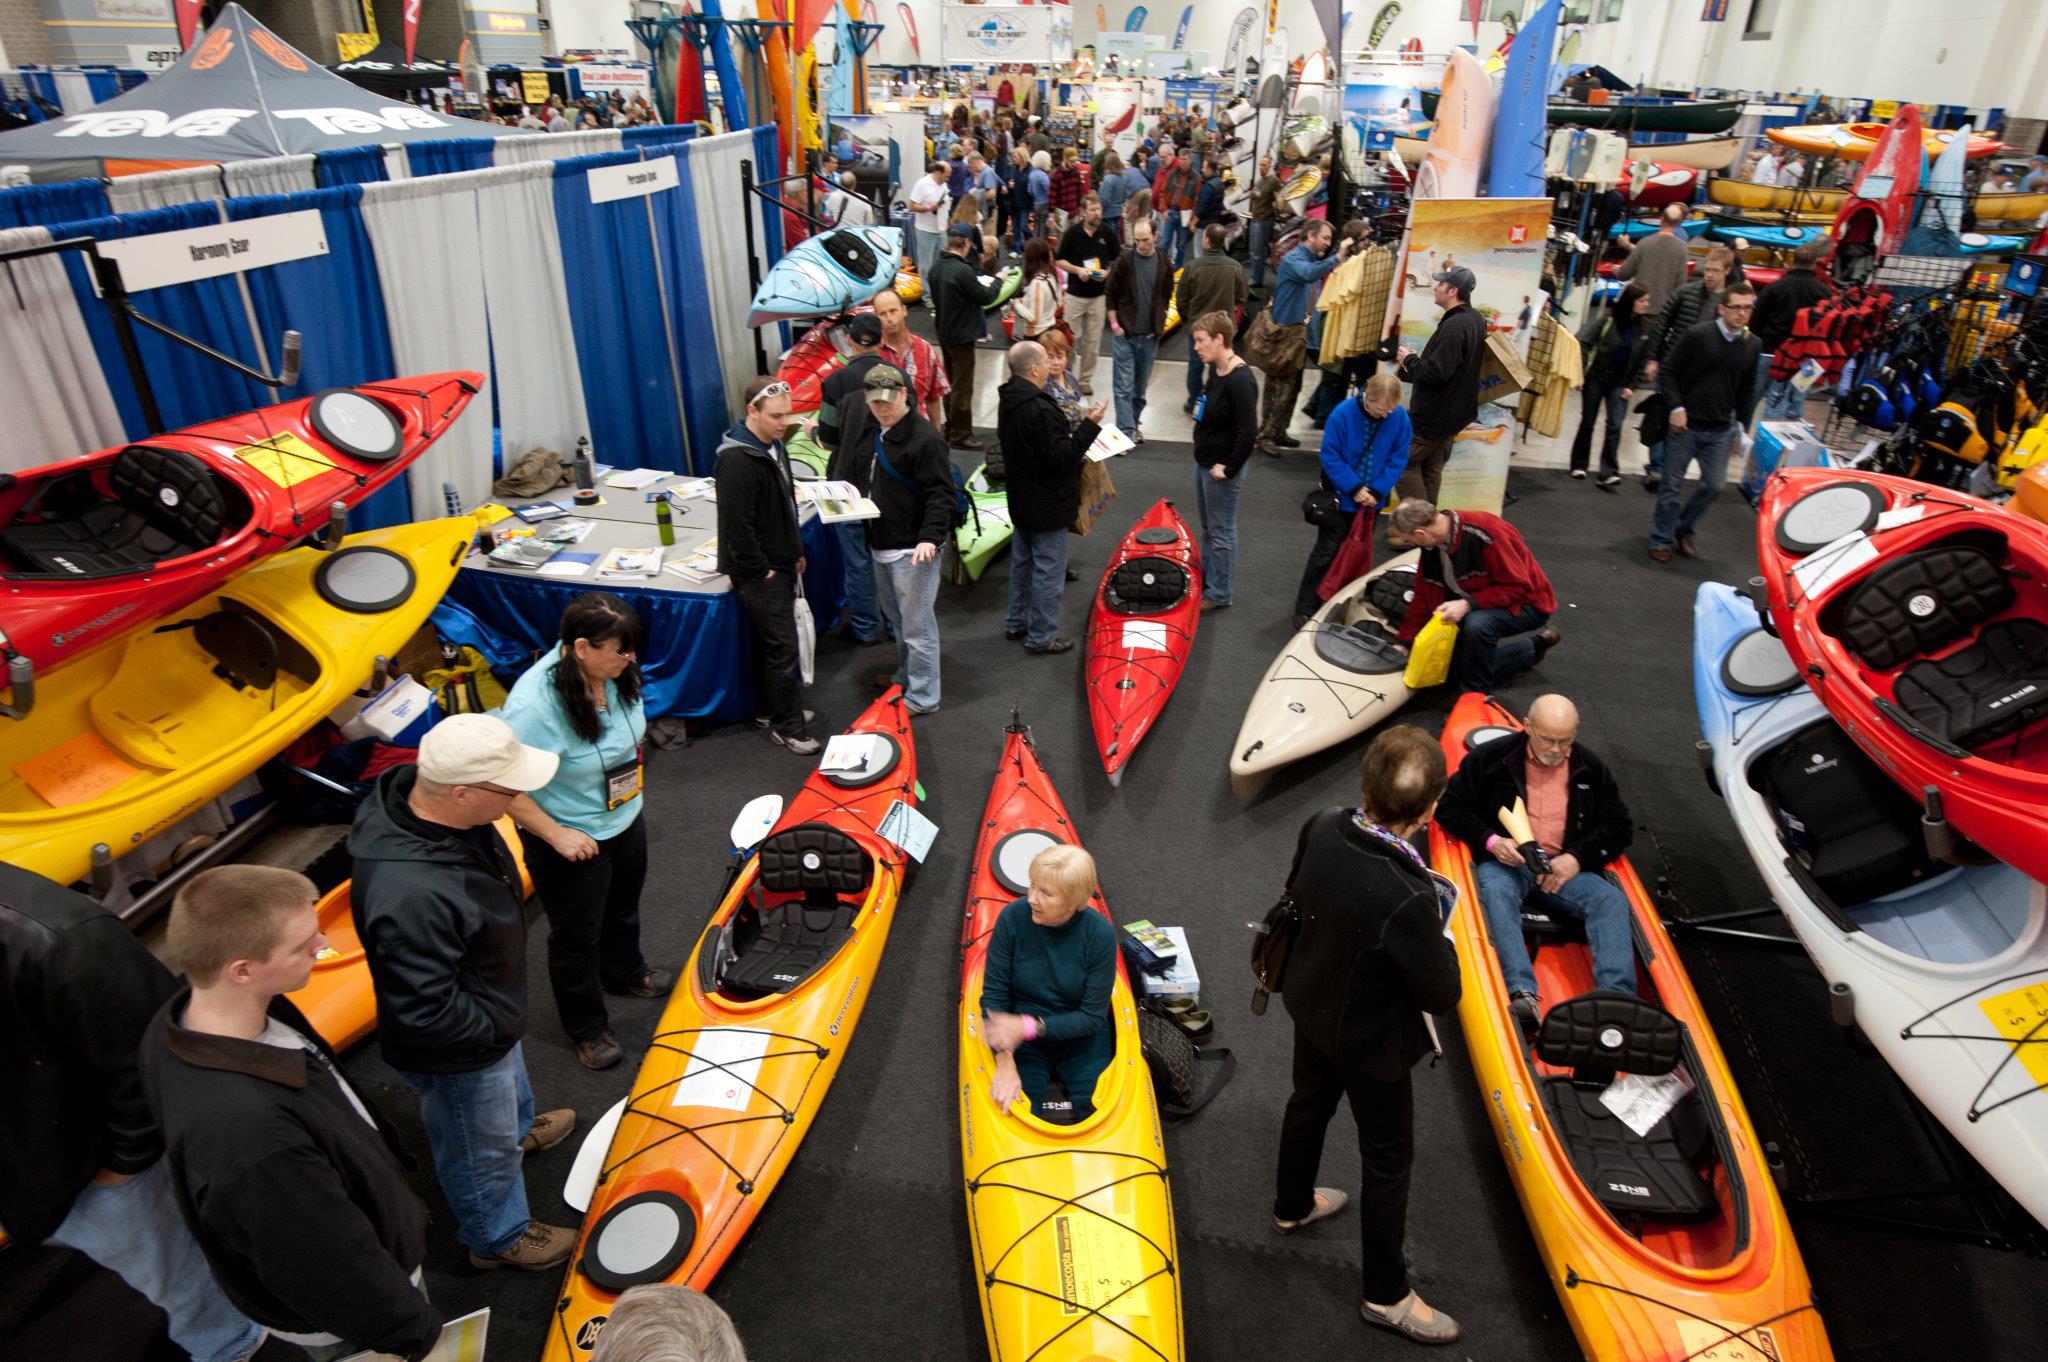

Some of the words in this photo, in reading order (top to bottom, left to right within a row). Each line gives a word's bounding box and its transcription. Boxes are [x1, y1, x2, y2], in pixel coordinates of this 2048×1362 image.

[966, 30, 981, 38] SEA
[984, 30, 993, 38] TO
[996, 30, 1026, 38] SUMMIT
[189, 242, 231, 262] Harmony
[229, 238, 250, 254] Gear
[1493, 246, 1538, 254] perception
[834, 975, 861, 1028] perception
[1062, 1252, 1077, 1311] Canoecopia
